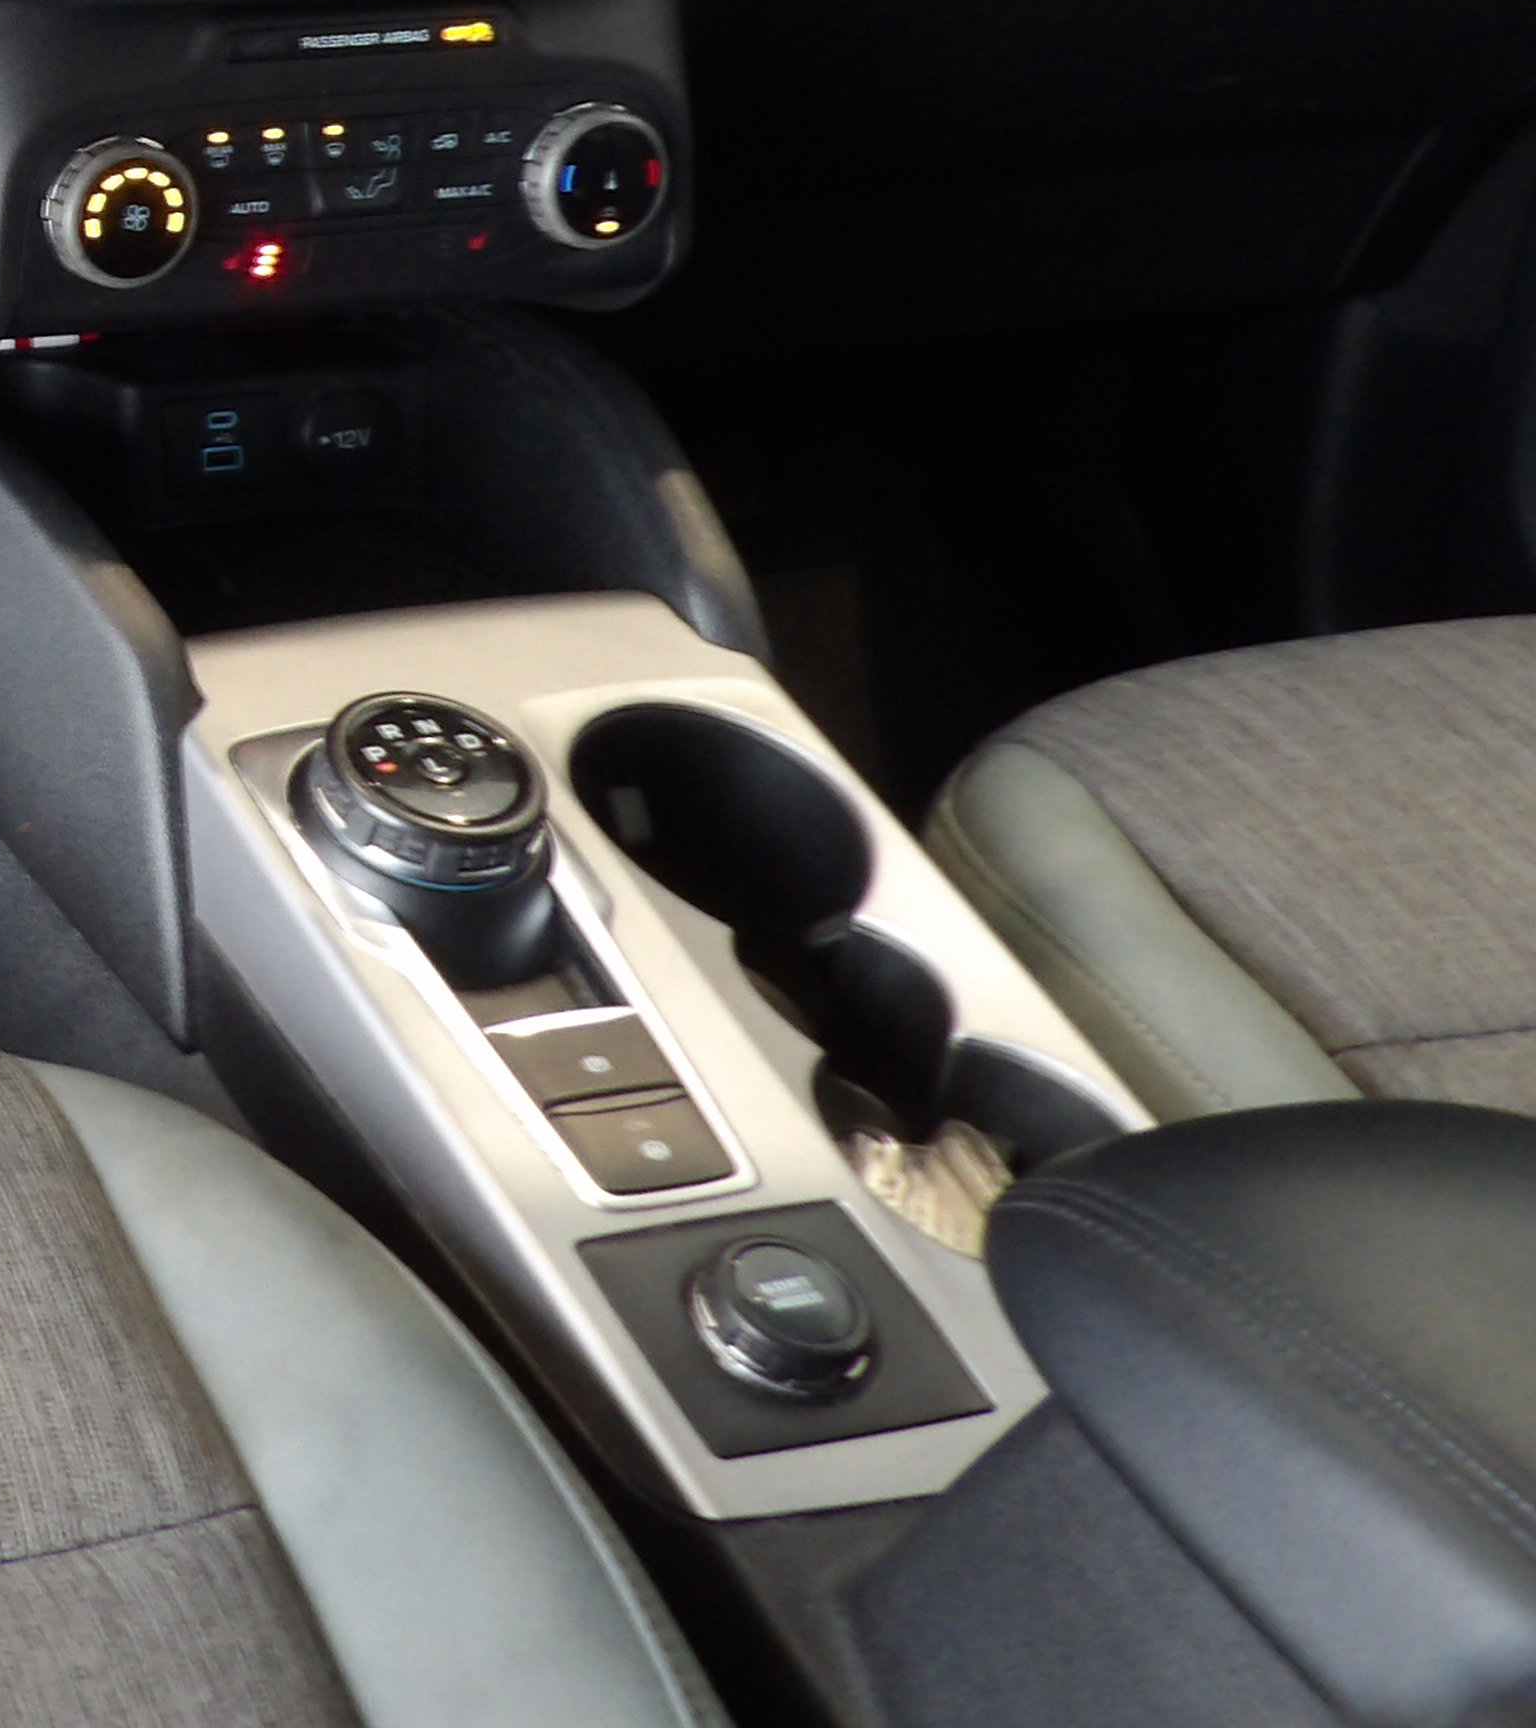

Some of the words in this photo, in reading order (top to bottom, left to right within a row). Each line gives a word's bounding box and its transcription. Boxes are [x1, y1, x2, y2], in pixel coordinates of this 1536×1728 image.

[298, 32, 380, 50] PASSENGER
[381, 29, 431, 44] AIRBAG
[230, 200, 270, 214] AUTO
[331, 427, 373, 450] 12V
[374, 723, 405, 740] R
[412, 718, 442, 734] N
[454, 732, 483, 750] D
[359, 745, 388, 763] P
